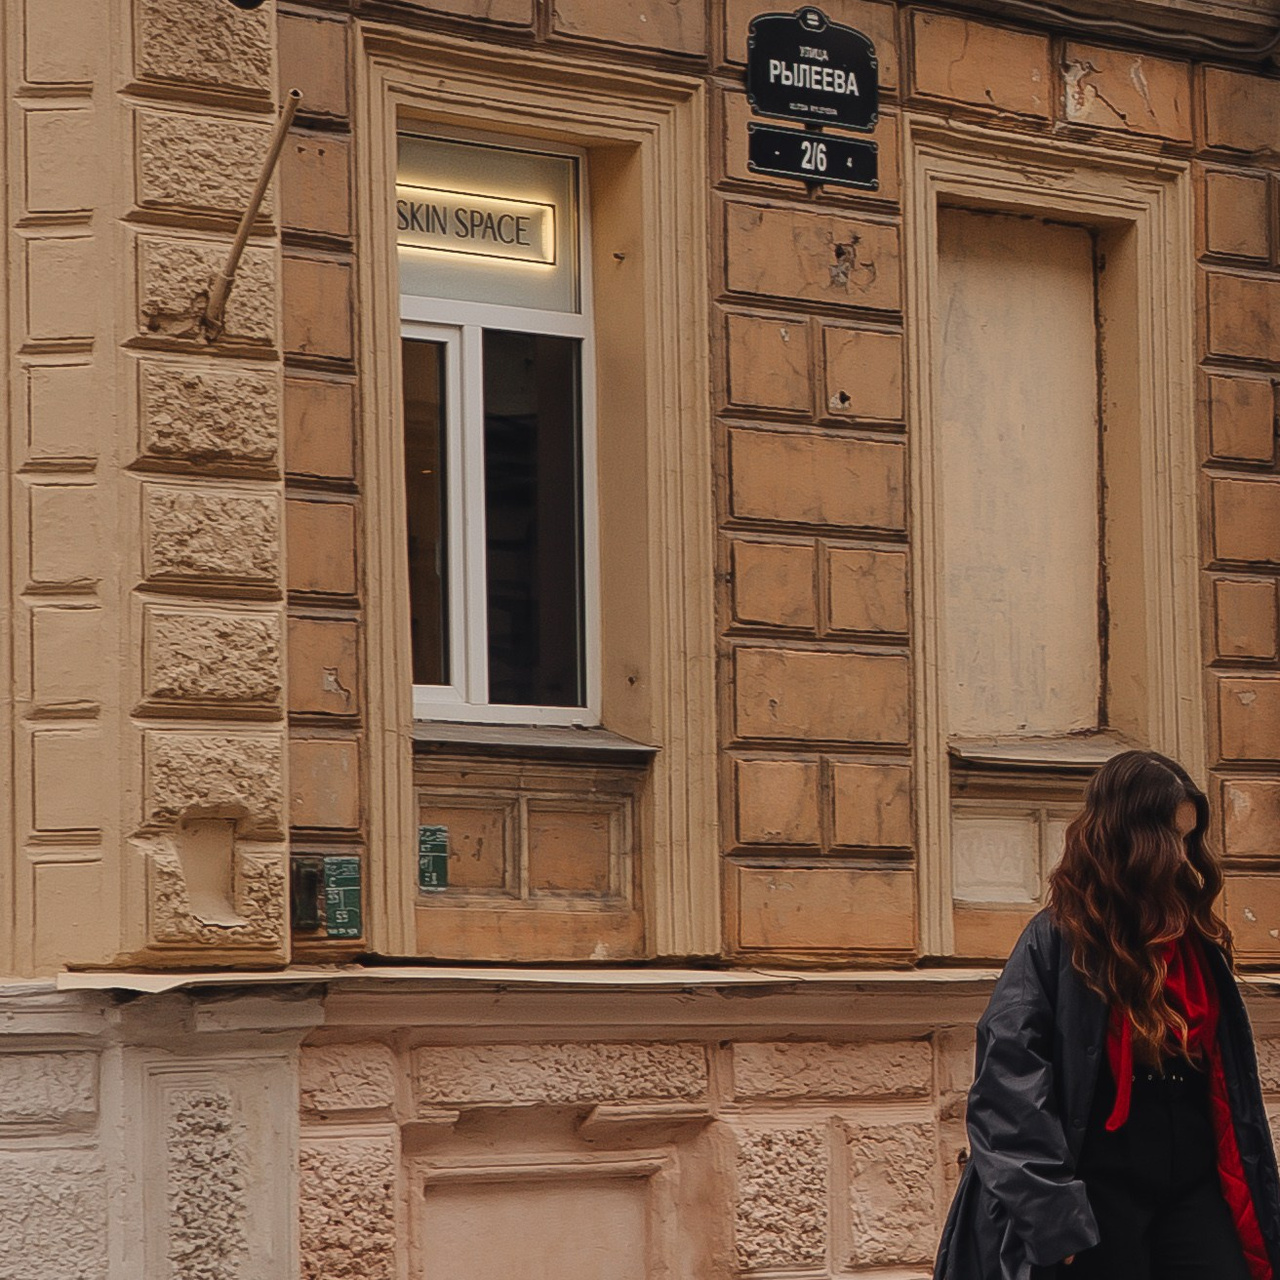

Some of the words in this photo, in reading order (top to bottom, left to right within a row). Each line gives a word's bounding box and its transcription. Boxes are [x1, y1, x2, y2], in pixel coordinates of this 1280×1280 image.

[769, 59, 860, 97] РЫЛЕЕВА
[801, 141, 827, 172] 2/6
[396, 199, 448, 235] SKIN
[454, 207, 531, 247] SPACE
